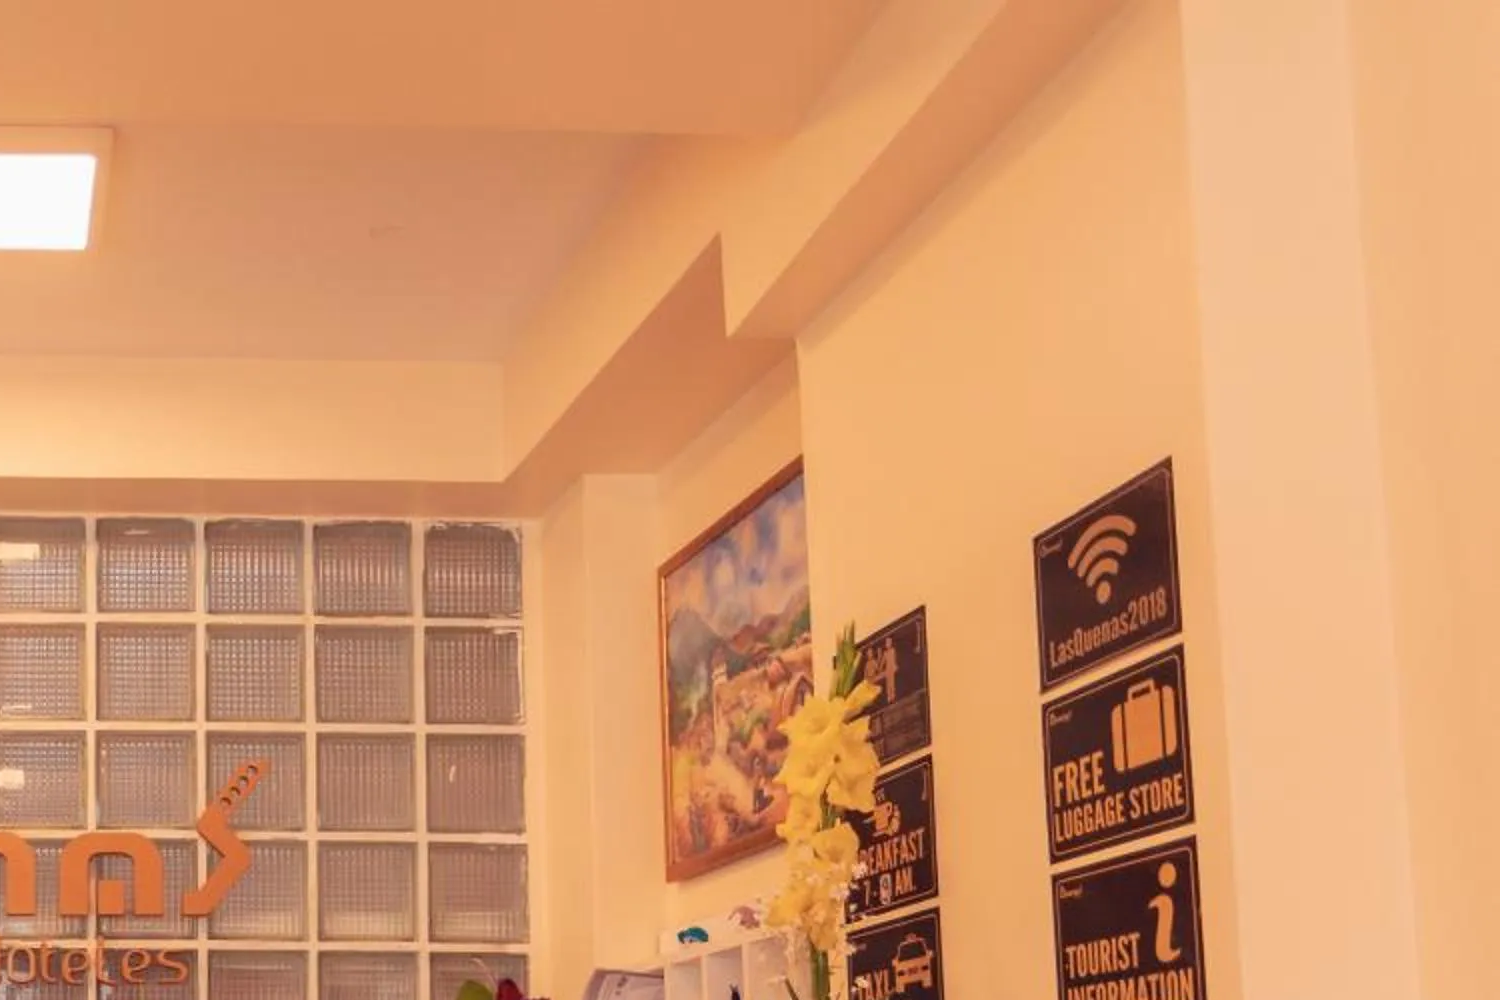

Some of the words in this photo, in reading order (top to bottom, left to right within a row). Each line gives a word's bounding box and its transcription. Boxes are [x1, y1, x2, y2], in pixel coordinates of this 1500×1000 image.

[1048, 586, 1168, 670] LasQuenas2018
[1052, 750, 1105, 806] FREE
[1053, 798, 1126, 842] LUGGAGE
[1129, 773, 1185, 818] STORE
[857, 826, 925, 876] REAKFAST
[1064, 933, 1142, 982] TOURIST
